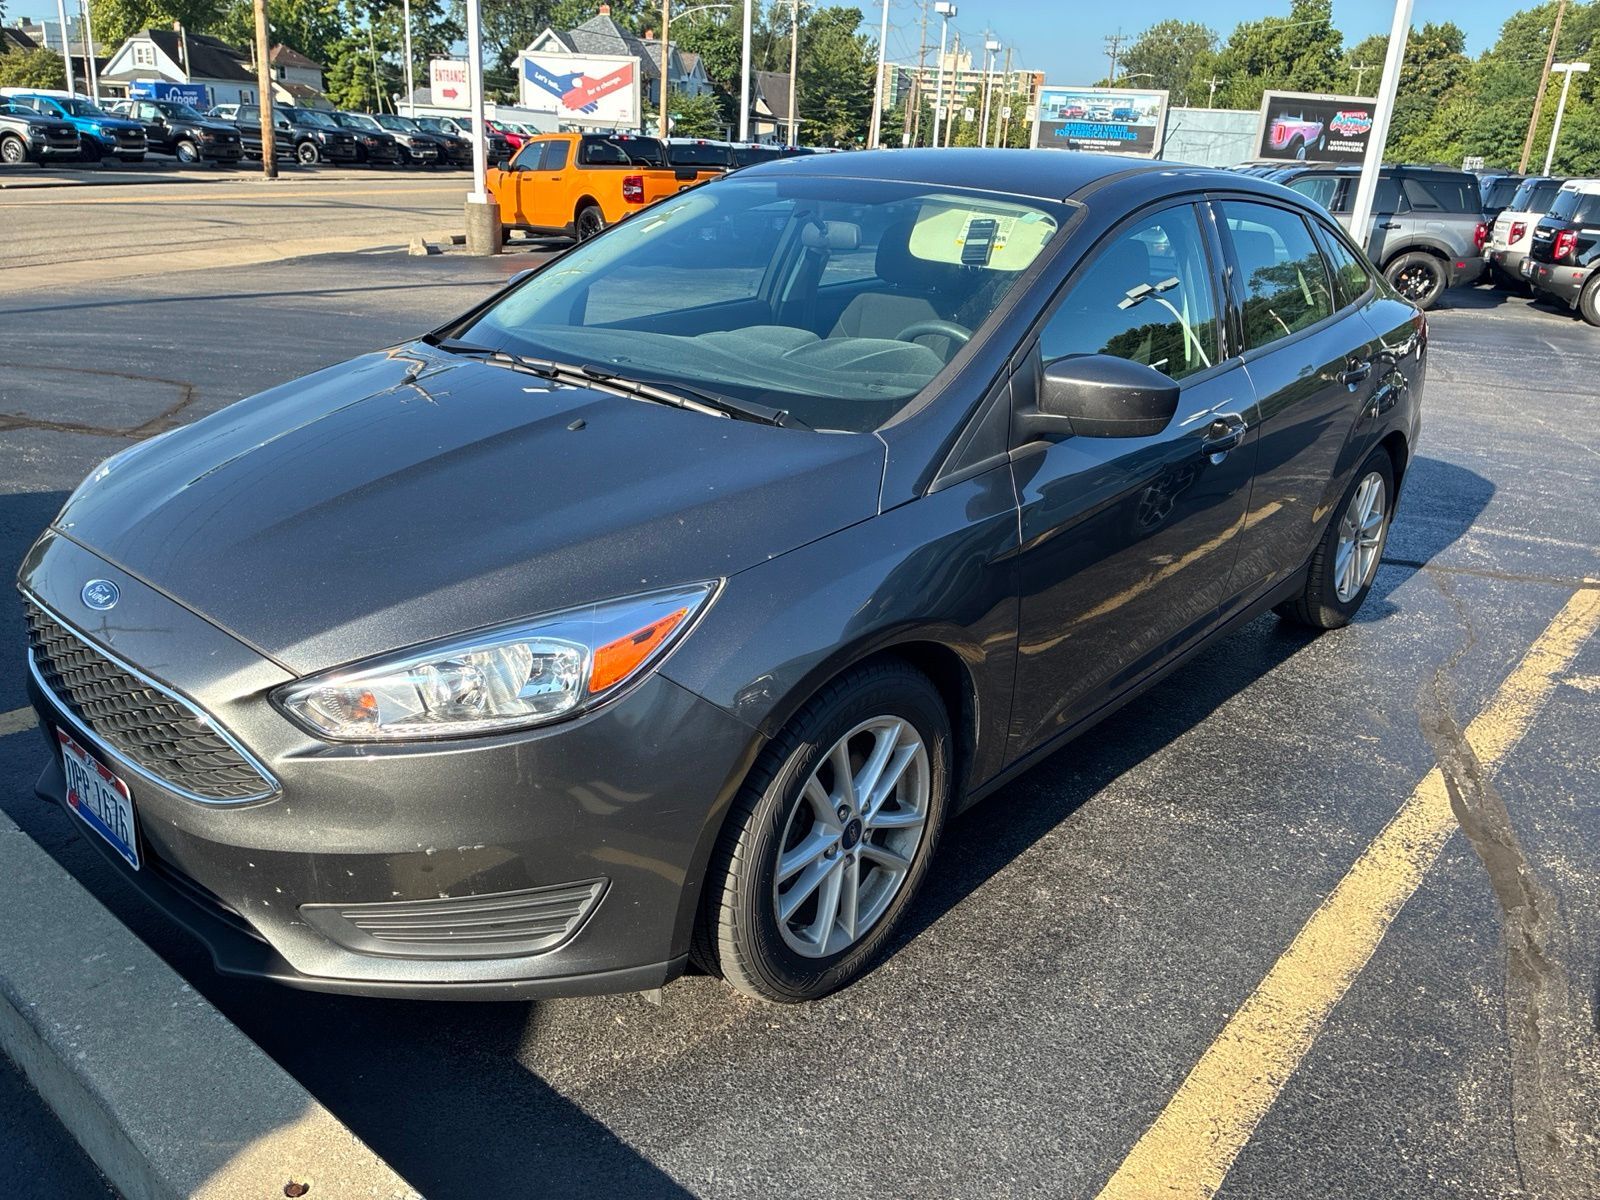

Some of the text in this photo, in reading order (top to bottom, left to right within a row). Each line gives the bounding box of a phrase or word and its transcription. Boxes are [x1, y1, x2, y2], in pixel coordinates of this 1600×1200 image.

[435, 69, 466, 83] ENTRANCE
[166, 87, 198, 106] Kroger
[1055, 129, 1138, 140] FOR AMERICAN VALUES
[1065, 123, 1128, 133] AMERICAN VALUE
[95, 781, 129, 846] 1676
